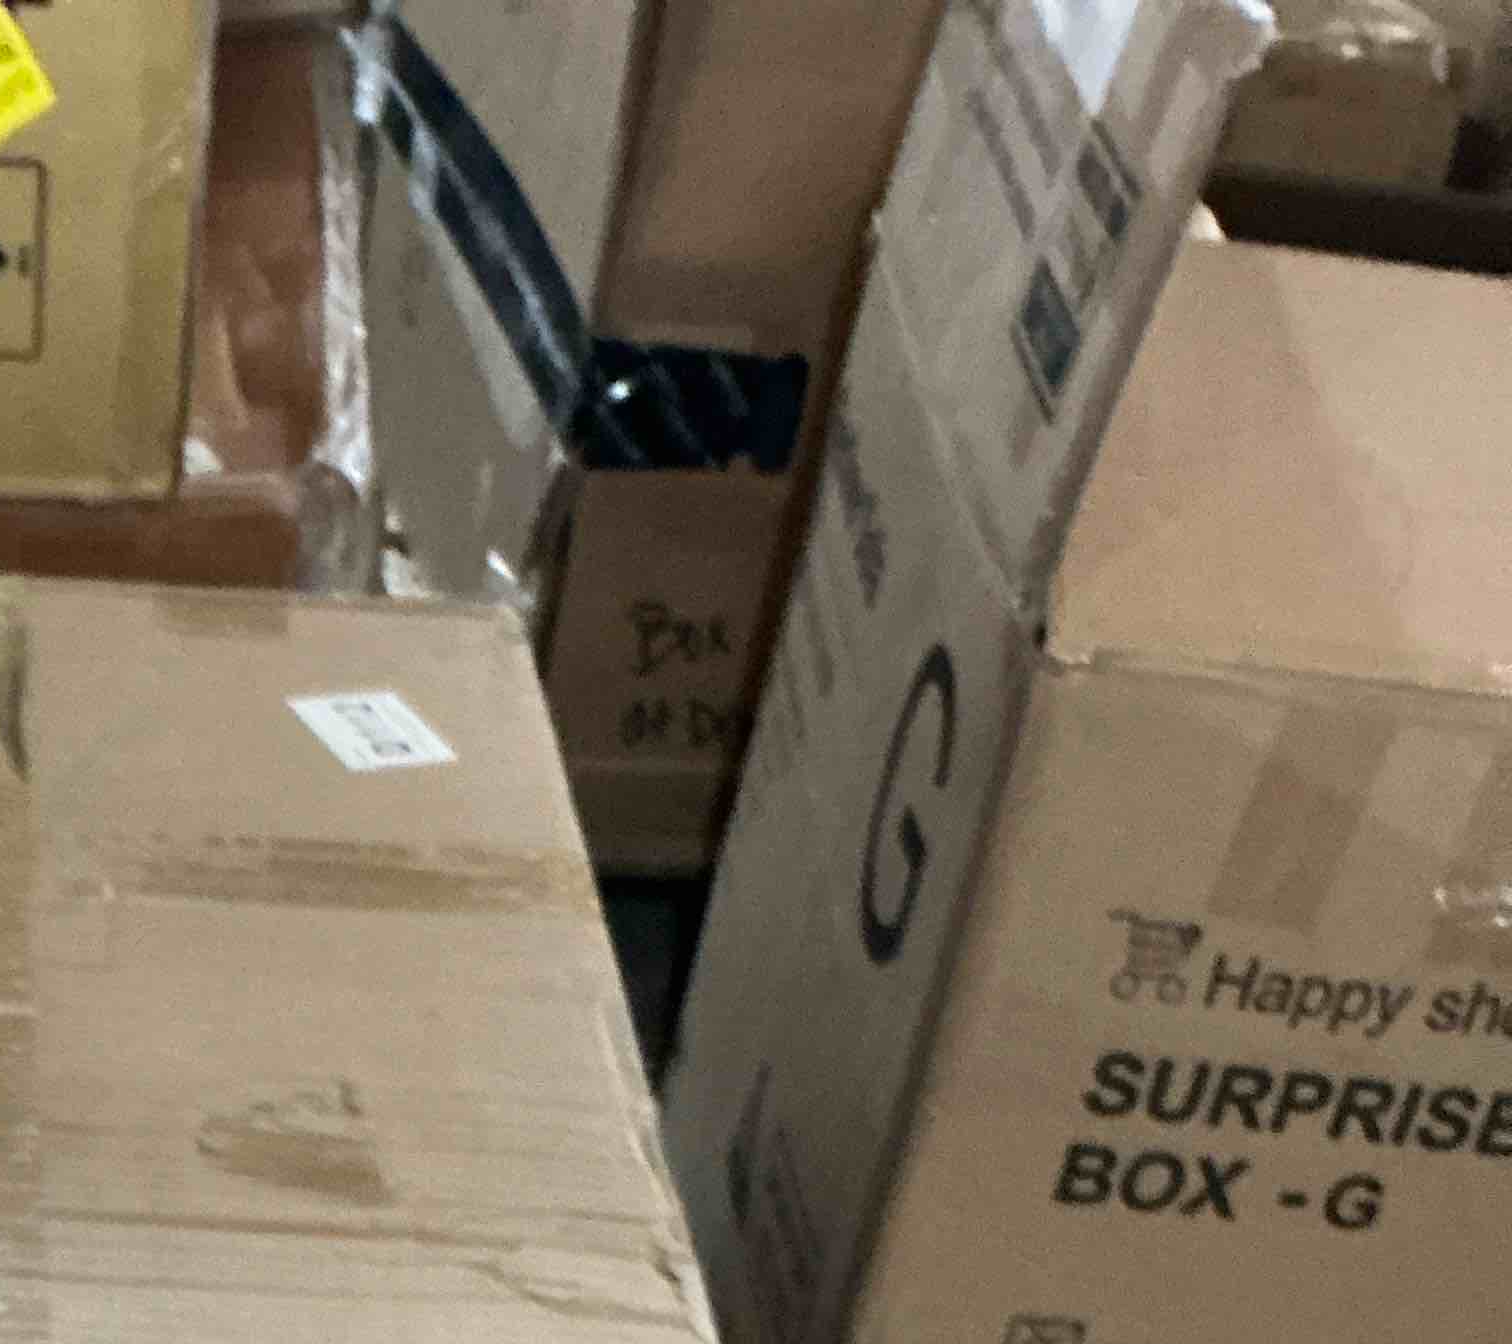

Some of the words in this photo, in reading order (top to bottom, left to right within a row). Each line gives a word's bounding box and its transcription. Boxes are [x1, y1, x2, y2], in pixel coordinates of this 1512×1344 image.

[859, 642, 957, 965] G
[1204, 951, 1414, 1039] Happy
[1424, 979, 1512, 1038] sh
[1082, 1048, 1512, 1158] SURPRISE
[1053, 1142, 1252, 1222] BOX
